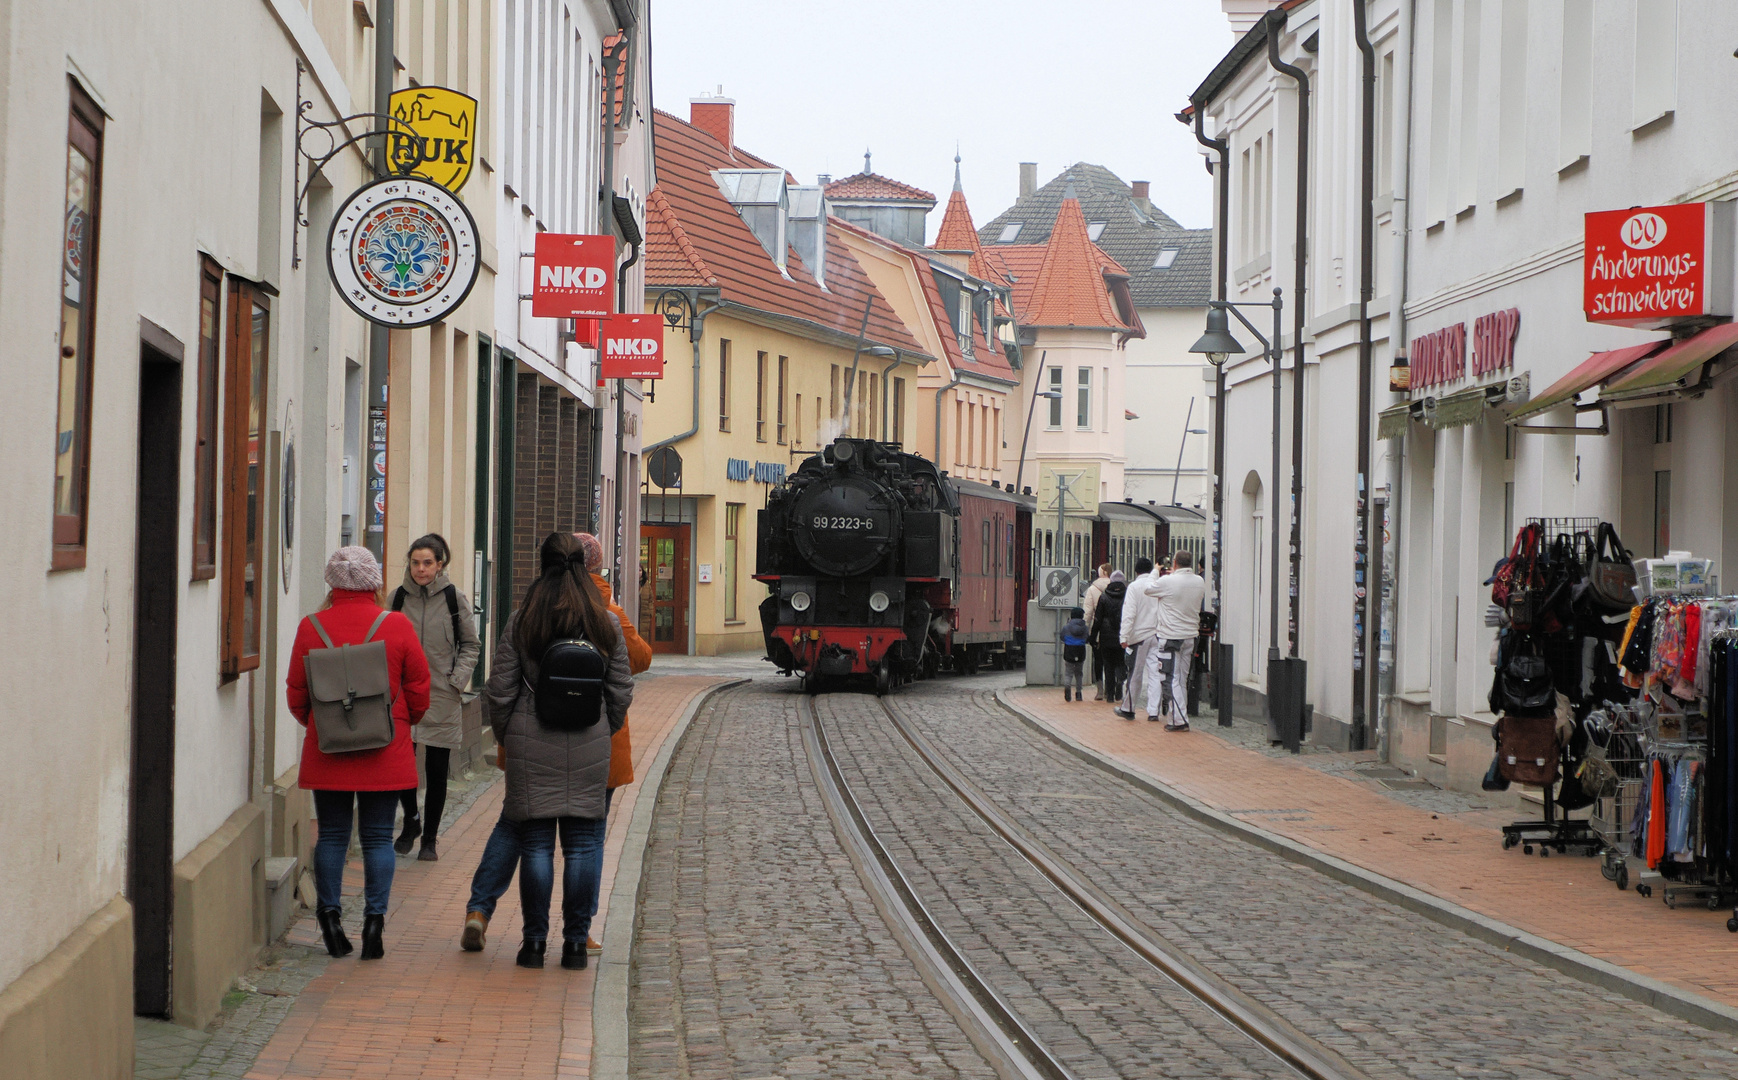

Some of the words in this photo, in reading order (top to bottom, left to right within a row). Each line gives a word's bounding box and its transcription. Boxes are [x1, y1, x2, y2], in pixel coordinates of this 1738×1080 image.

[391, 134, 468, 165] HUK
[337, 195, 373, 241] Alte
[383, 185, 472, 249] Glaserei
[540, 265, 607, 289] NKD
[1591, 245, 1697, 285] Änderungs-
[351, 288, 451, 319] Bistro
[1592, 280, 1695, 315] schneiderei
[606, 338, 659, 356] NKD
[1408, 322, 1466, 391] MODERN
[1471, 307, 1521, 377] SHOP
[813, 516, 829, 529] 99
[830, 516, 874, 530] 2323-6
[1047, 598, 1069, 606] ZONE
